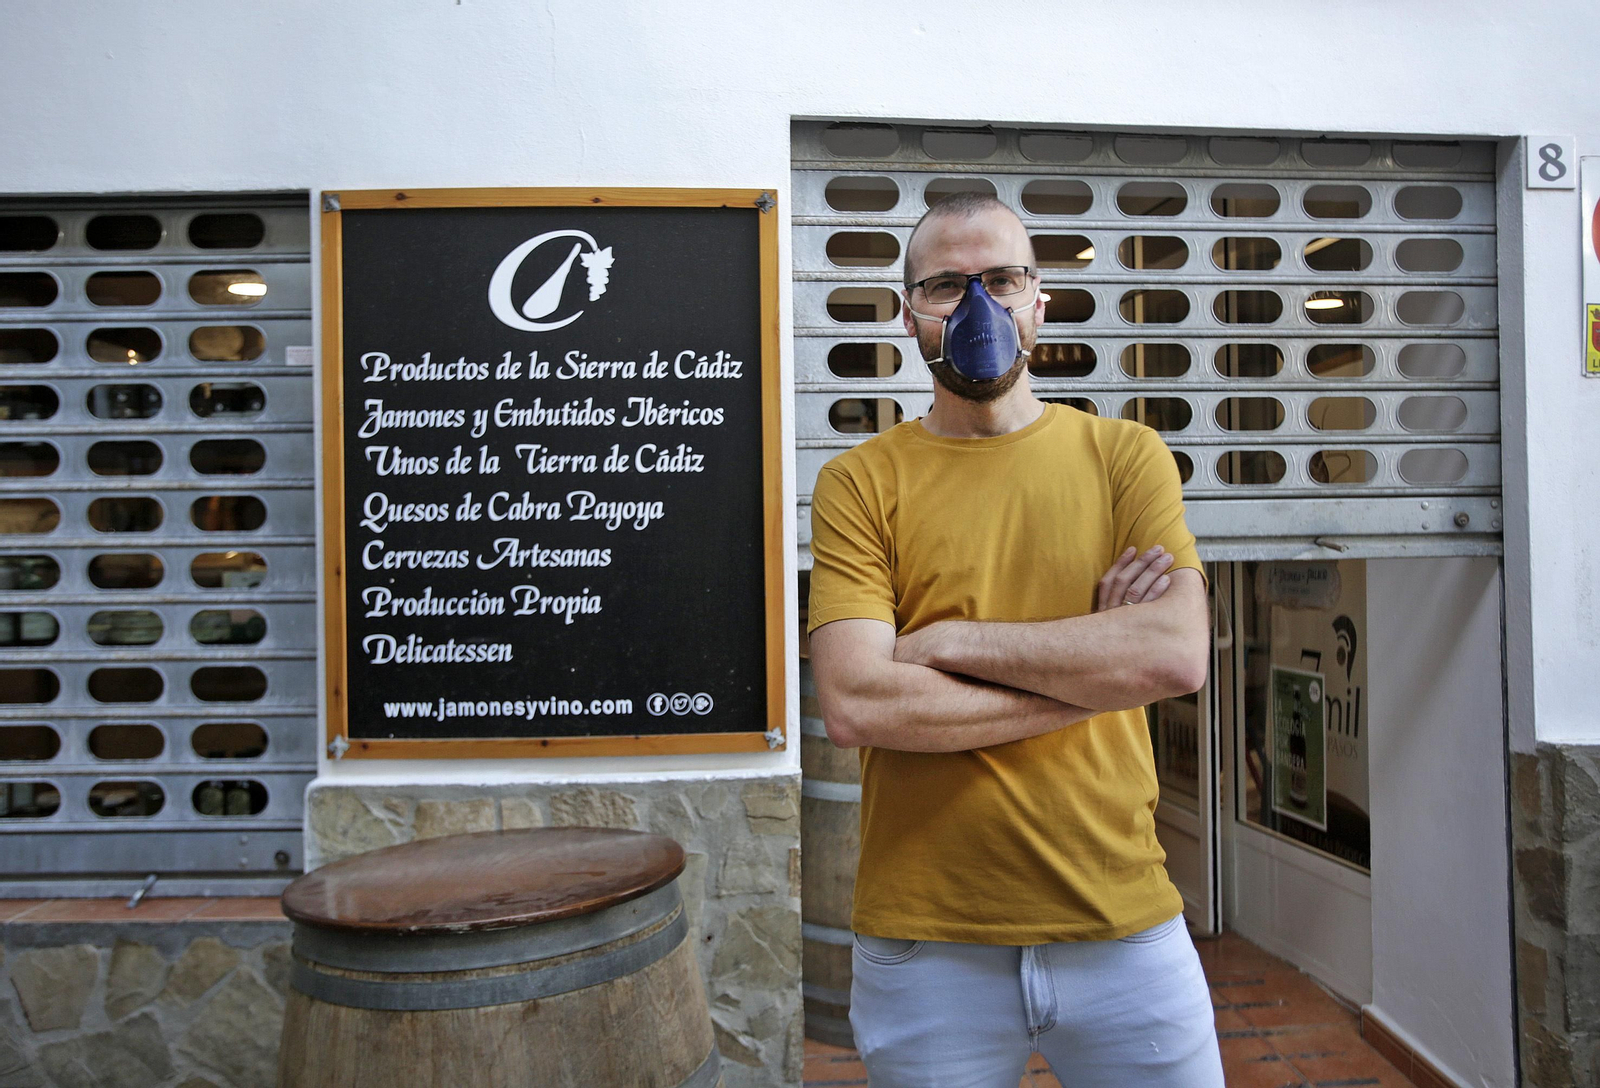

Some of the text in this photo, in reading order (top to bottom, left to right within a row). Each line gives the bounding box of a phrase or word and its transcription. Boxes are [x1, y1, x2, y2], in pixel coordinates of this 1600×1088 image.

[1538, 143, 1567, 182] 8
[360, 349, 743, 383] Productos de la Sierra de Cádiz
[357, 396, 725, 439] Jamones y Embutidos Ibéricos
[364, 443, 705, 476] Vinos de la Tierra de Cádiz
[359, 490, 665, 534] Quesos de Cabra Payoya
[362, 537, 612, 571] Cervezas Artesanas
[361, 584, 603, 625] Producción Propia
[362, 633, 514, 665] Delicatessen
[383, 695, 633, 722] www.jamonesyvino.com
